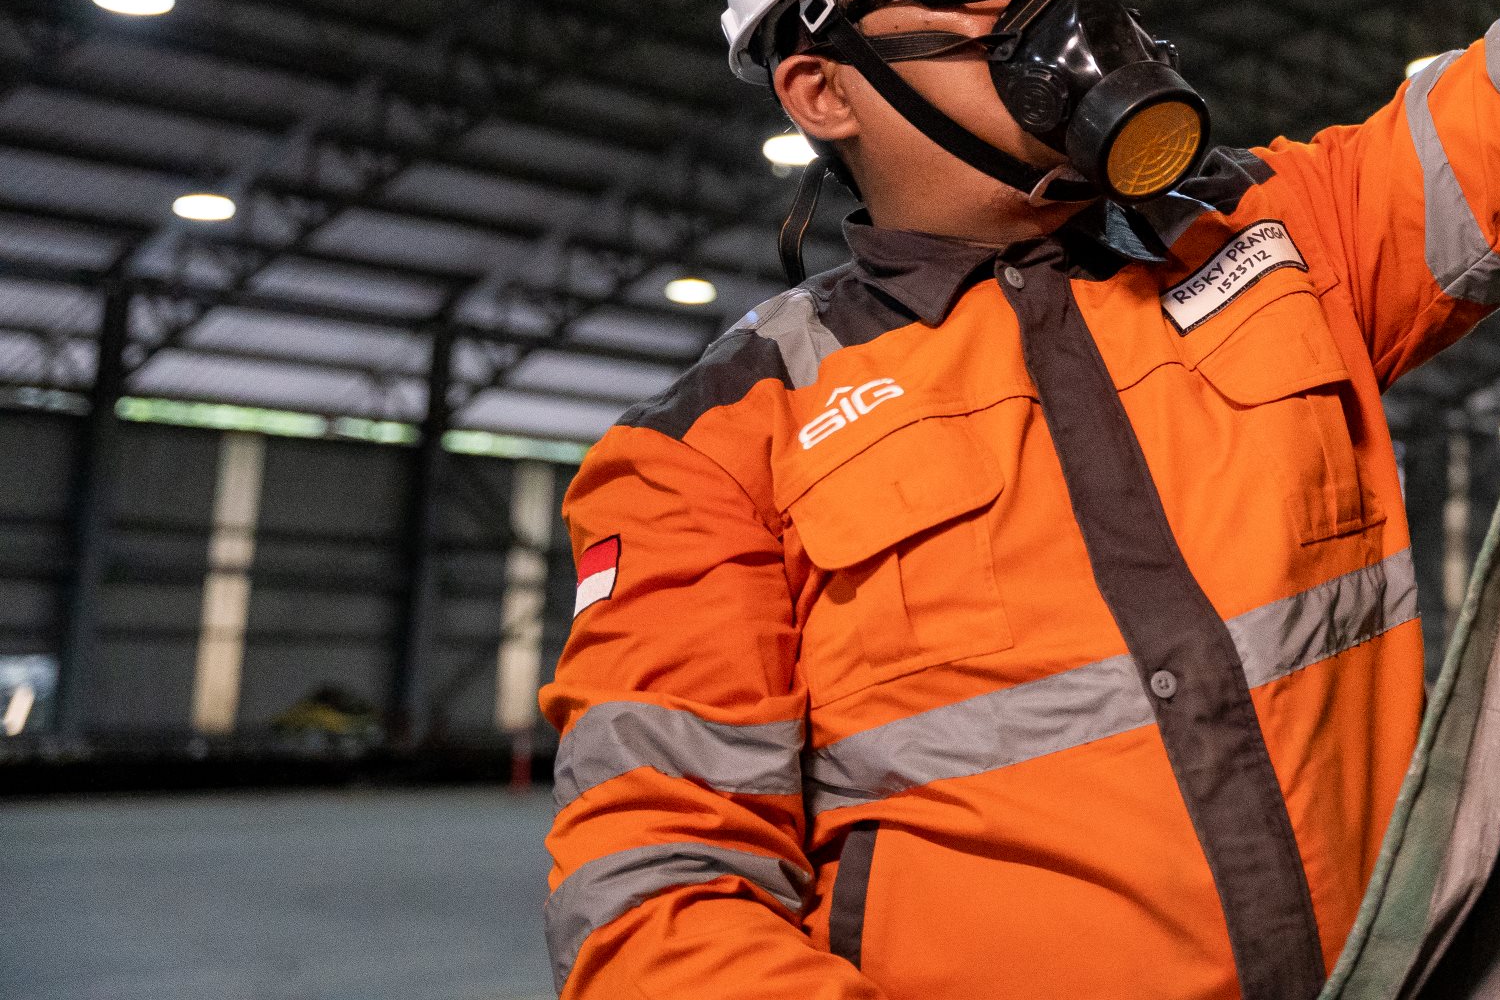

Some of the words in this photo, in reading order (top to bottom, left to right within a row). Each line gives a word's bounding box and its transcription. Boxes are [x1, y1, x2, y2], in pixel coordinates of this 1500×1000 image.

[1172, 262, 1225, 304] RISKY
[1226, 227, 1286, 262] PRAYOGA
[1216, 249, 1272, 294] 1523712
[799, 378, 904, 450] SIG
